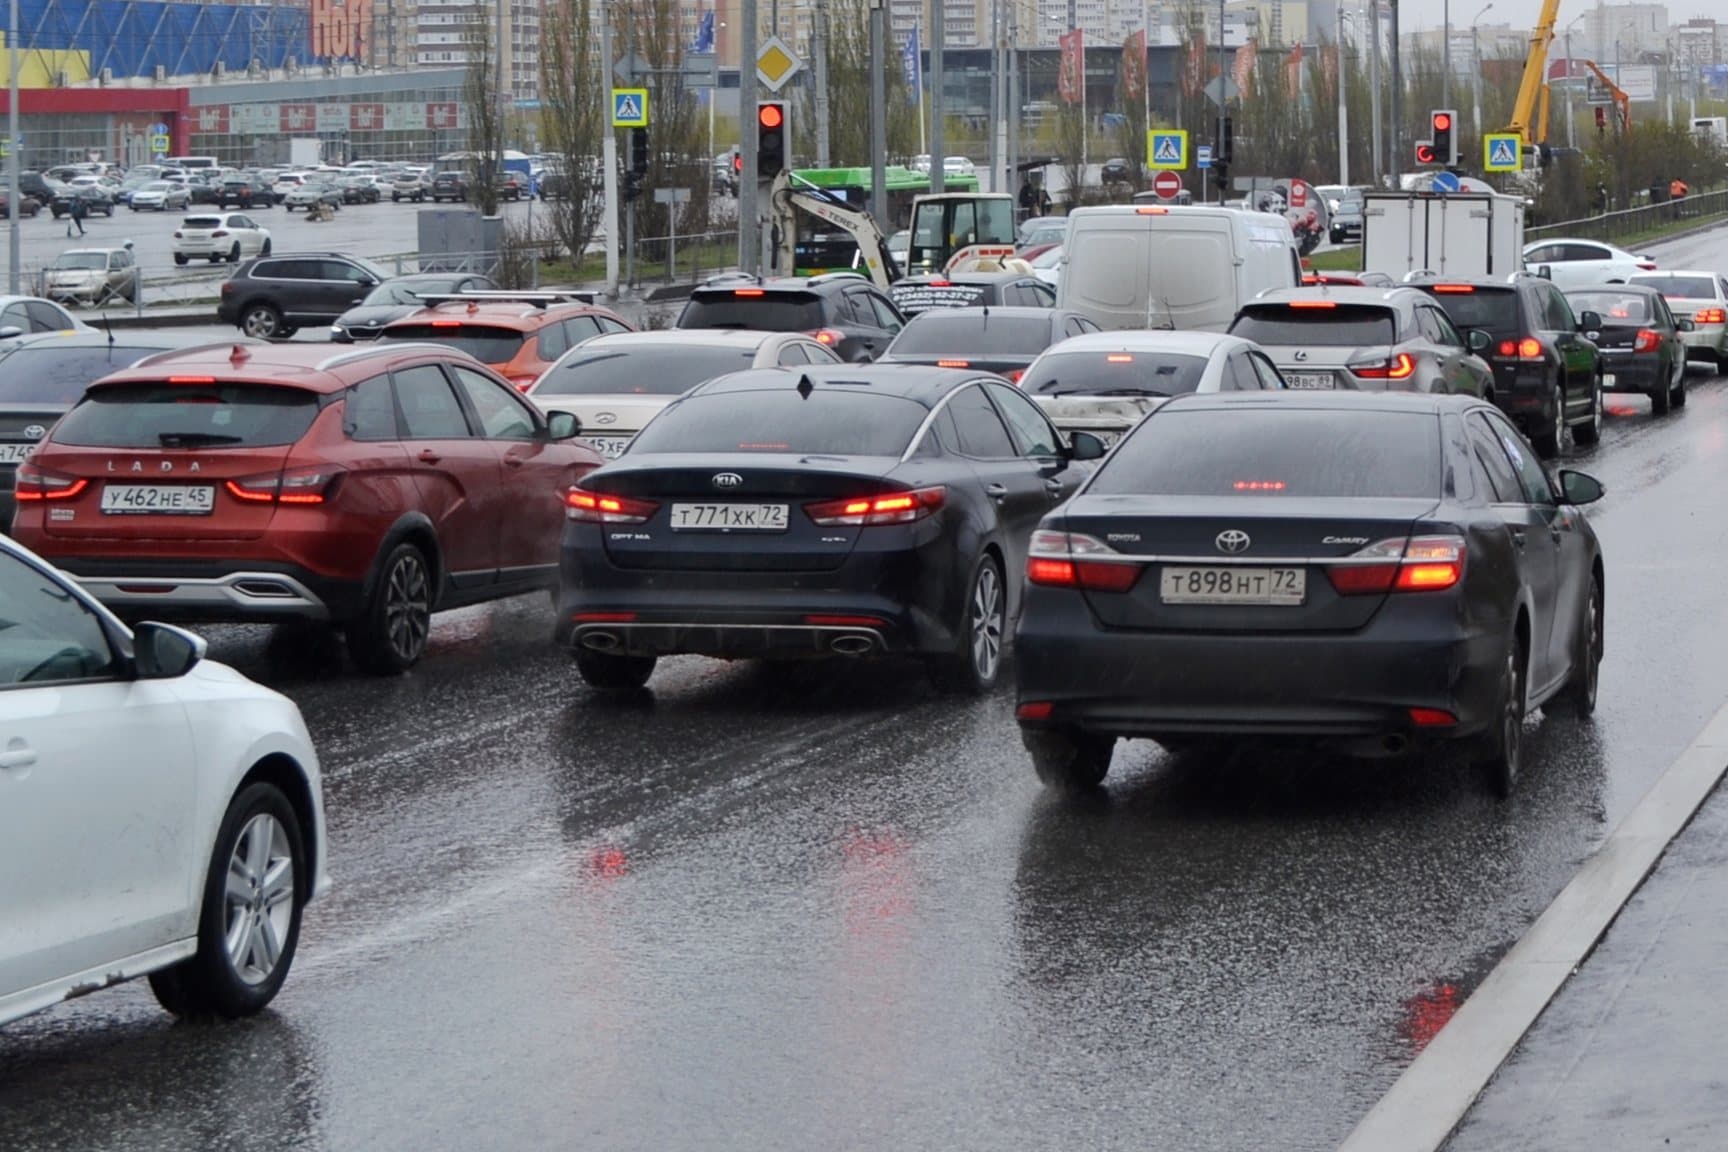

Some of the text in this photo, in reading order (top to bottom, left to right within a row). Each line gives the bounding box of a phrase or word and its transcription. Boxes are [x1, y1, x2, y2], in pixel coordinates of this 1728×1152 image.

[107, 459, 201, 472] LADA
[716, 475, 738, 486] KIA
[188, 488, 207, 502] 45
[763, 505, 781, 520] 72
[1107, 533, 1141, 543] TOYOTA
[1273, 570, 1297, 588] 72
